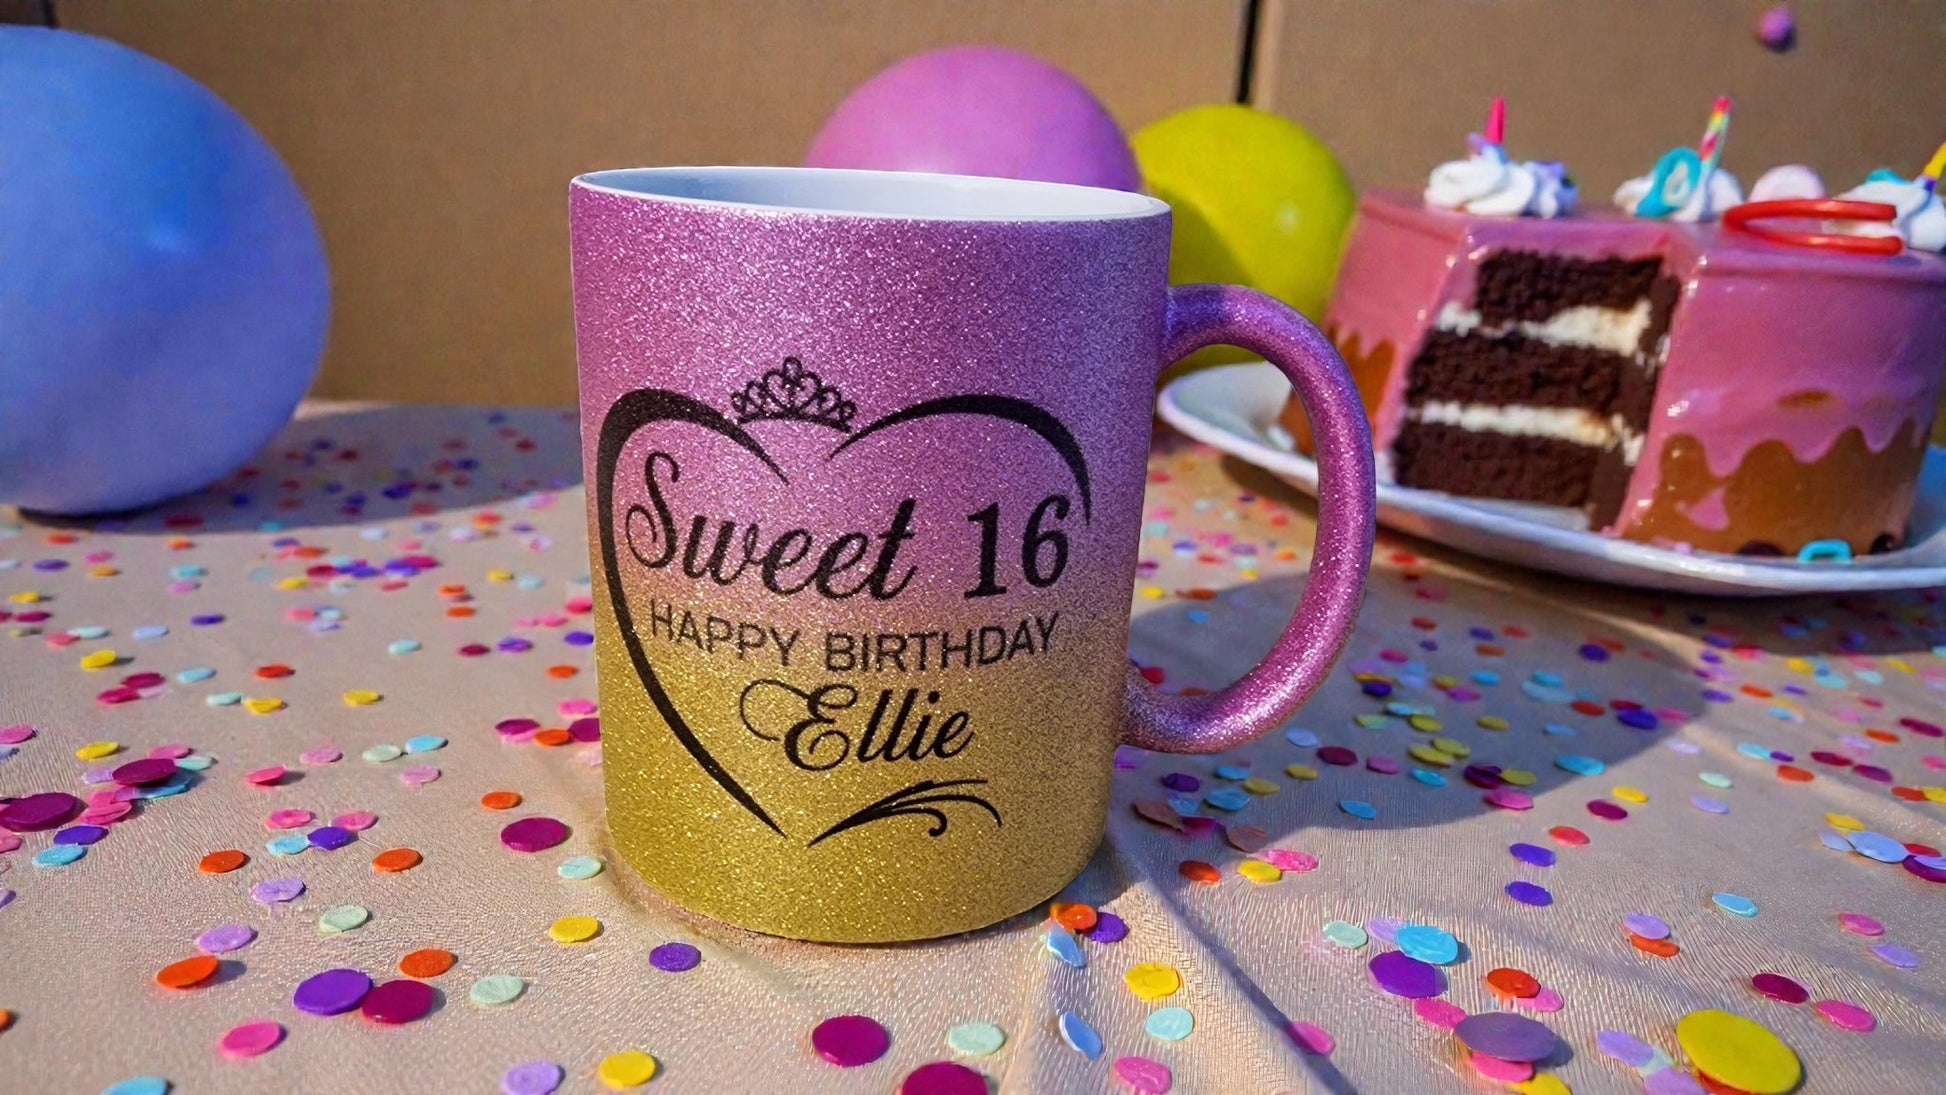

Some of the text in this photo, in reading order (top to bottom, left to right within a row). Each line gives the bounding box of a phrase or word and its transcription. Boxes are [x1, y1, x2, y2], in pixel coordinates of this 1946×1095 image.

[625, 452, 1072, 600] Sweet 16
[649, 599, 1059, 672] HAPPY BIRTHDAY
[739, 679, 975, 771] Ellie
